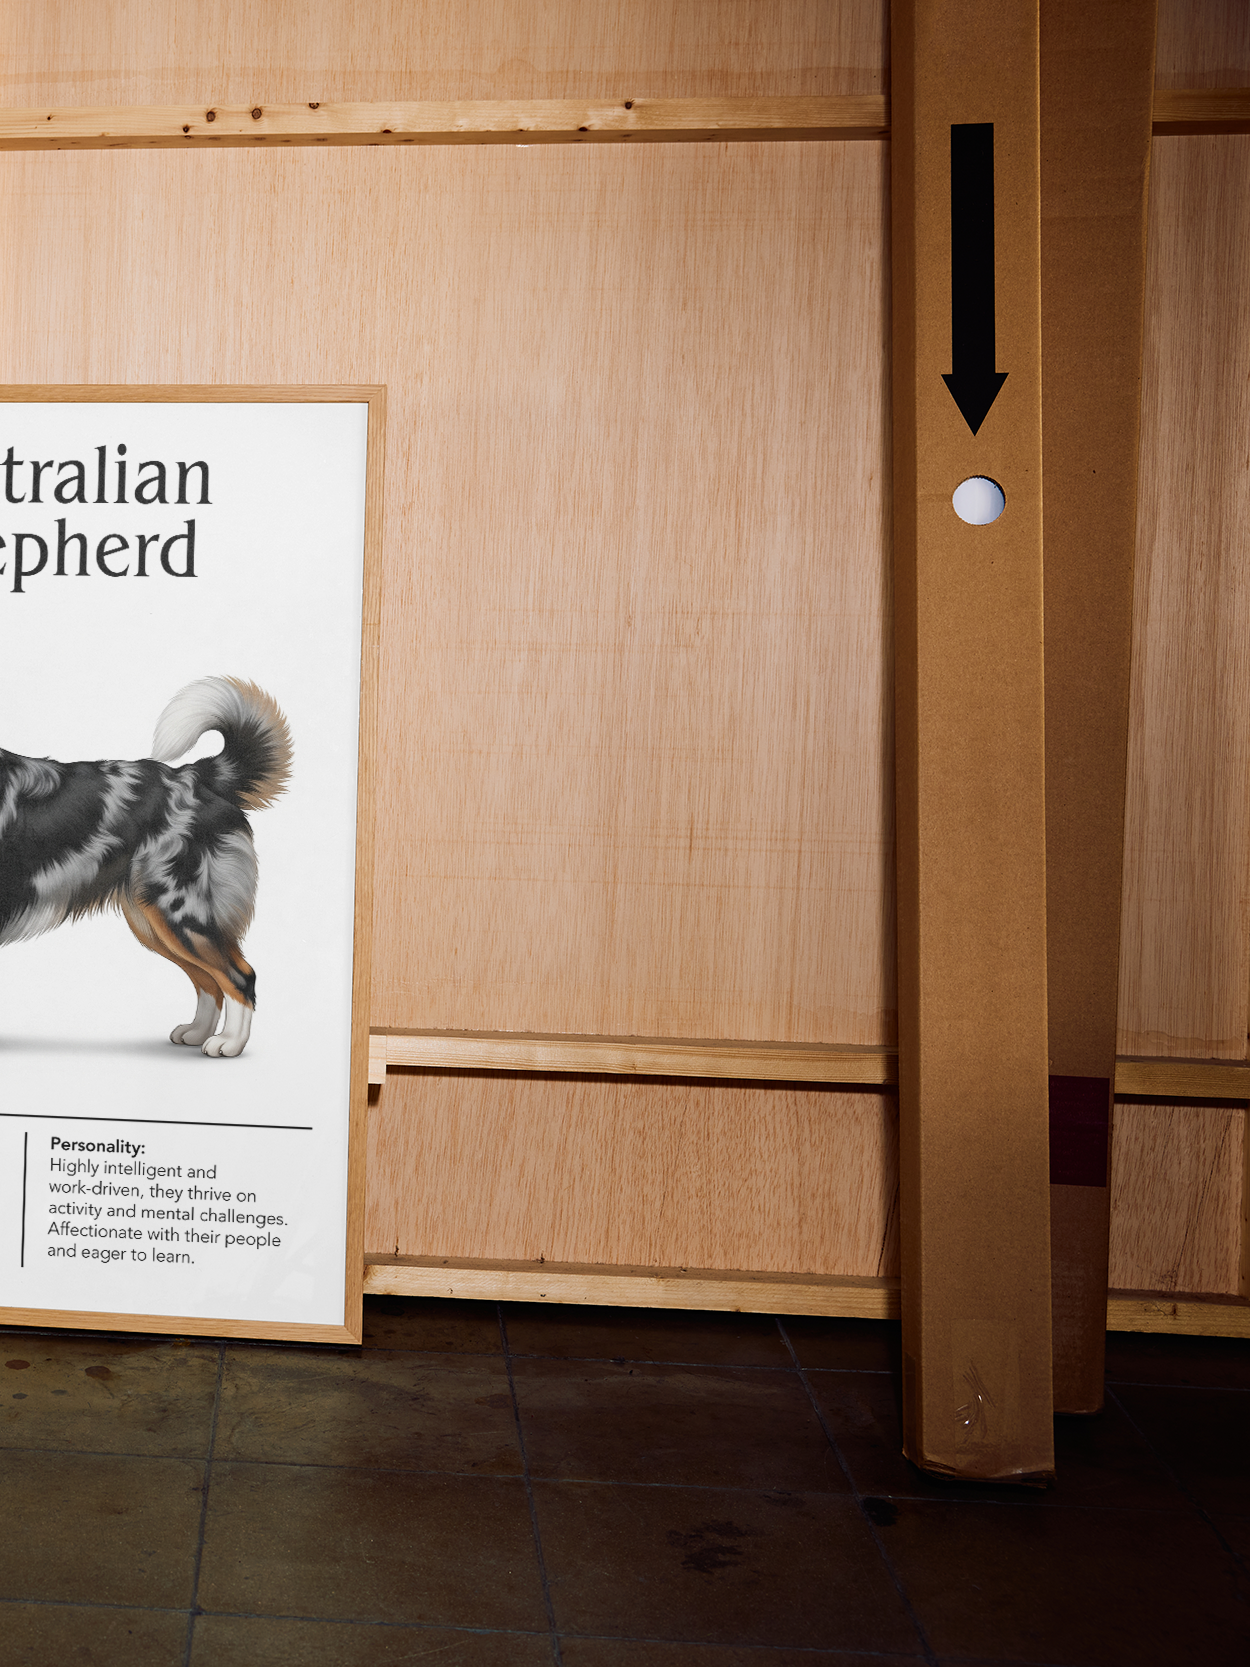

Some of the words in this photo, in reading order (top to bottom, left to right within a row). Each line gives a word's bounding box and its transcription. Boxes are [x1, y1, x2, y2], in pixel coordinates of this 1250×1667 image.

[50, 1135, 146, 1159] Personality:
[50, 1157, 100, 1178] Highly
[103, 1160, 183, 1181] intelligent
[186, 1164, 217, 1180] and
[48, 1179, 144, 1200] work-driven,
[148, 1182, 184, 1204] they
[186, 1184, 232, 1202] thrive
[235, 1191, 257, 1203] on
[48, 1201, 103, 1221] activity
[106, 1203, 137, 1219] and
[141, 1206, 195, 1222] mental
[199, 1207, 289, 1230] challenges.
[46, 1220, 143, 1240] Affectionate
[147, 1226, 180, 1242] with
[183, 1227, 222, 1244] their
[224, 1231, 282, 1250] people
[47, 1242, 77, 1258] and
[80, 1248, 128, 1264] eager
[130, 1248, 147, 1262] to
[152, 1246, 195, 1265] learn.
